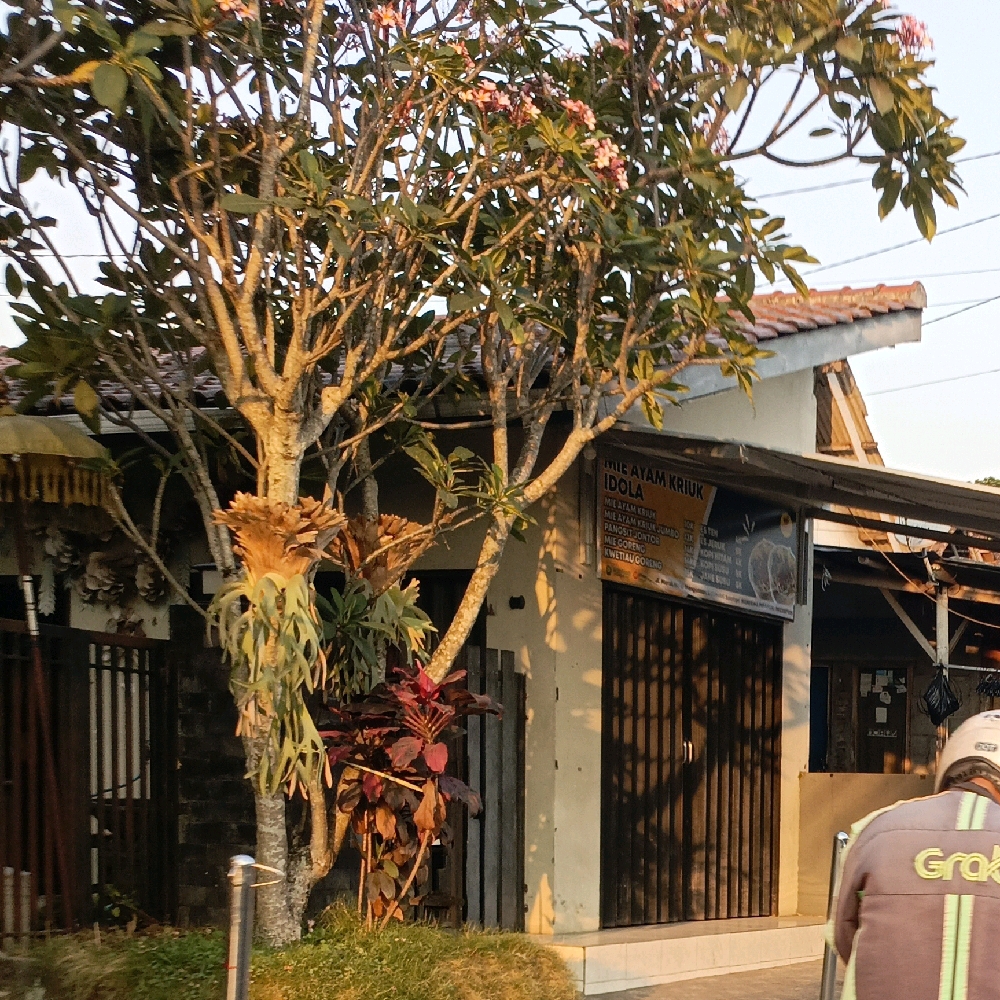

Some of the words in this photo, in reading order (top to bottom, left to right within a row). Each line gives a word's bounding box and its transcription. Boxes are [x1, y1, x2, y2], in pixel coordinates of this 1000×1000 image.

[604, 460, 628, 475] MIE
[631, 465, 667, 487] AYAM
[669, 474, 703, 500] KRIUK
[604, 472, 644, 501] IDOLA
[604, 547, 633, 564] KWETIAU
[634, 555, 663, 570] GORENG
[617, 538, 646, 554] GORENG
